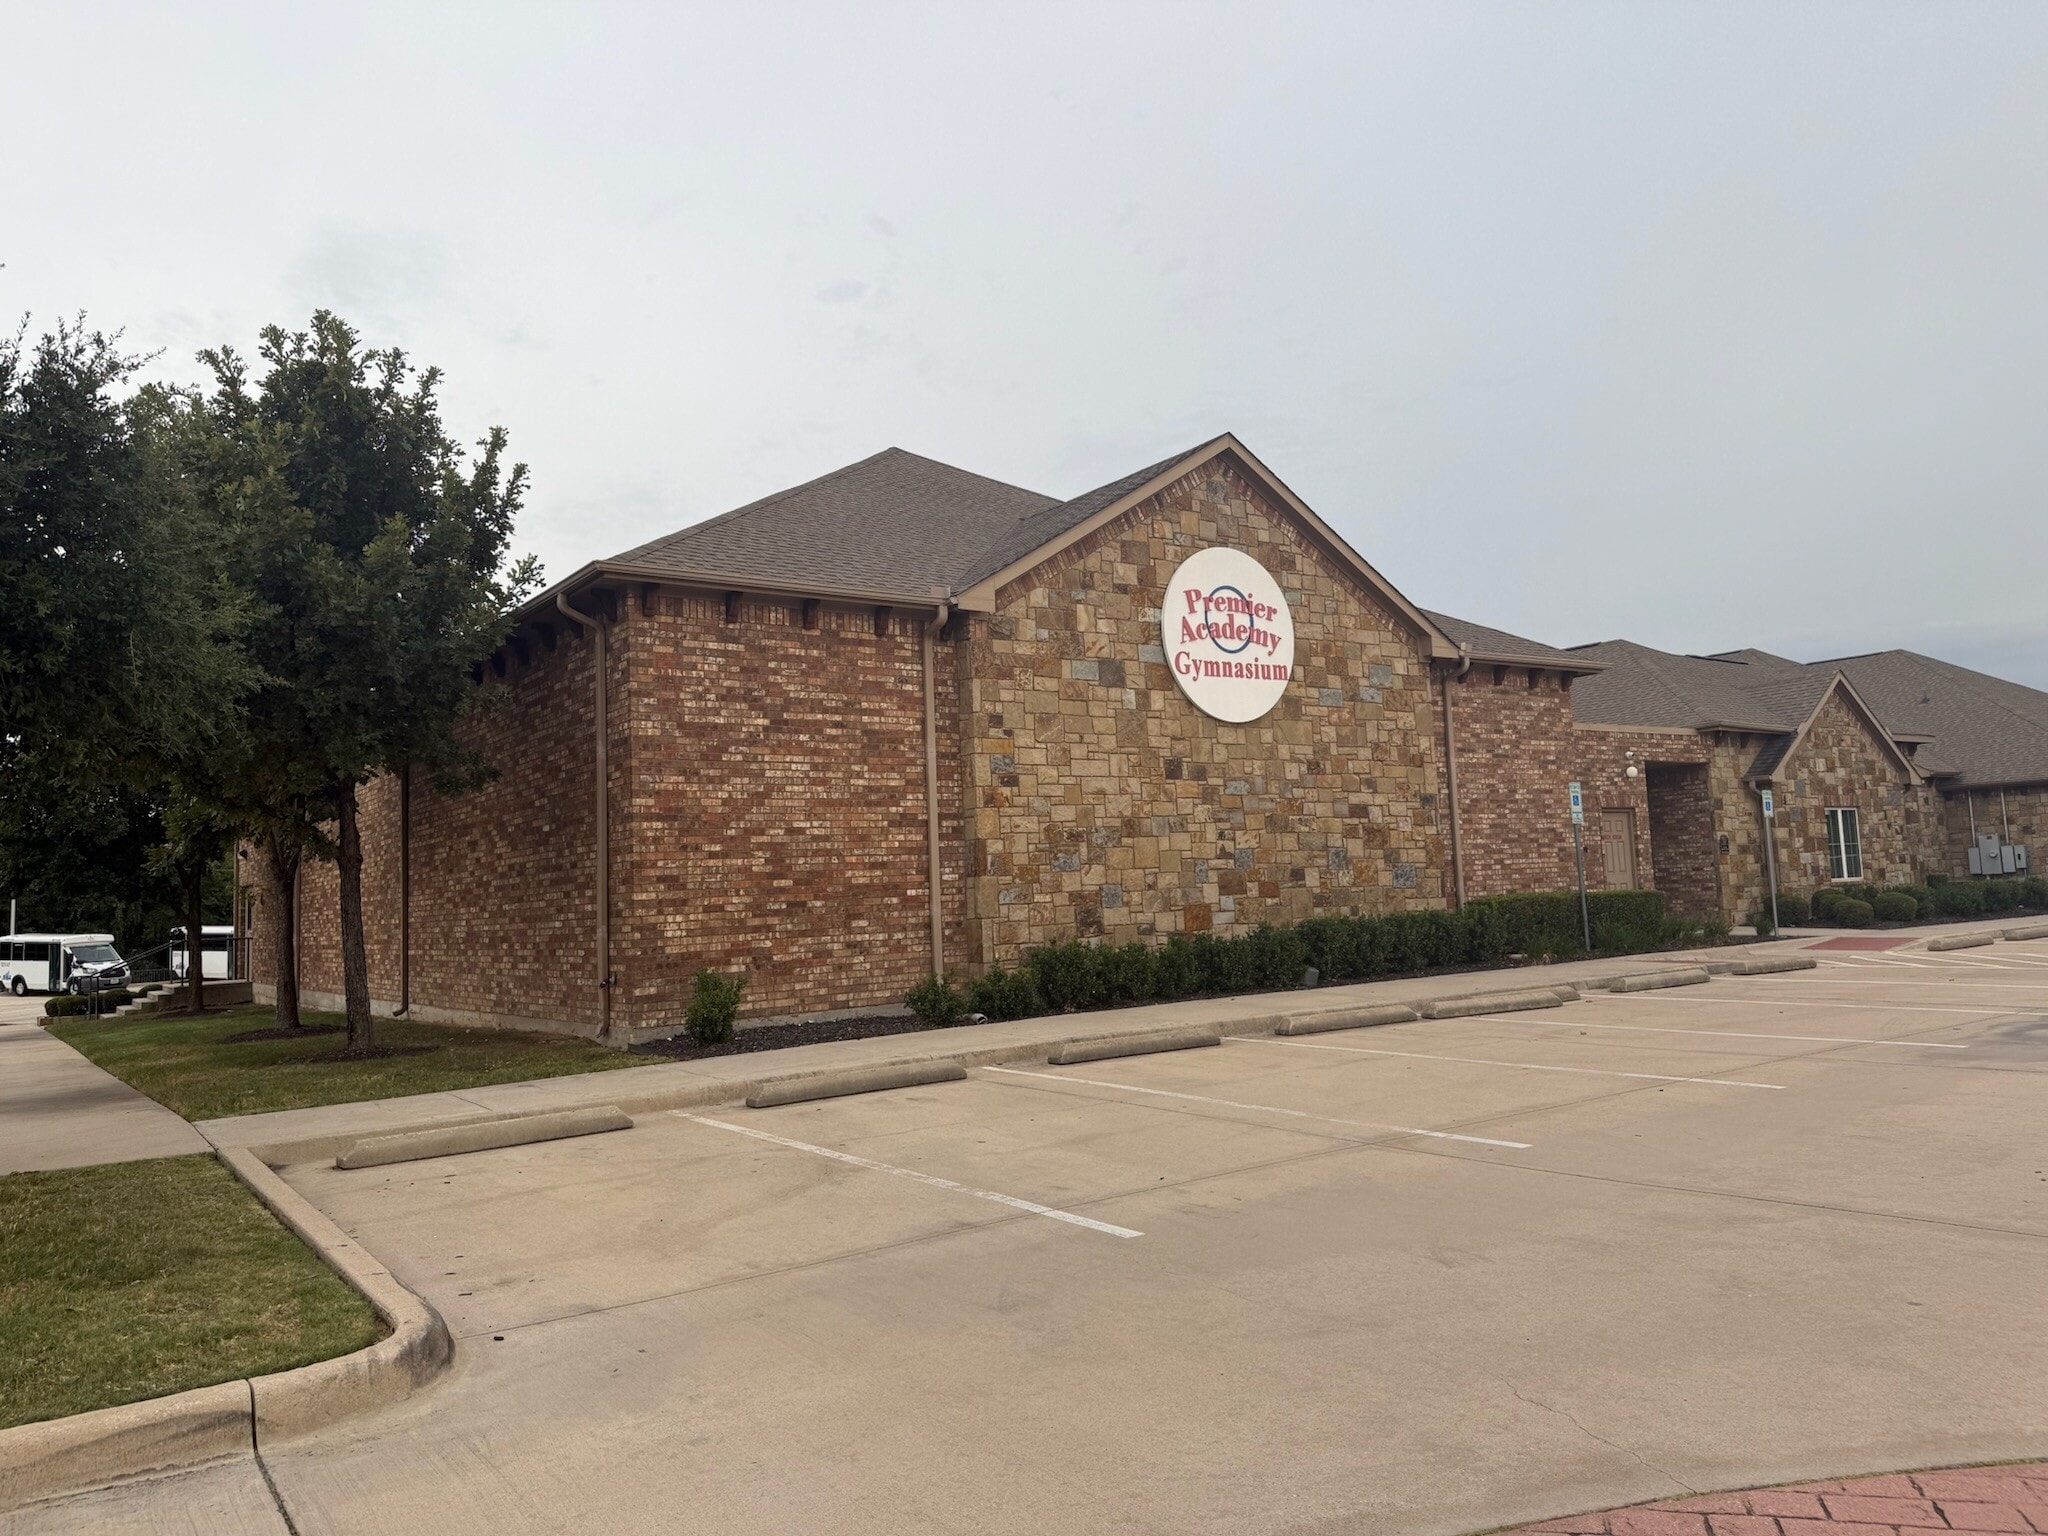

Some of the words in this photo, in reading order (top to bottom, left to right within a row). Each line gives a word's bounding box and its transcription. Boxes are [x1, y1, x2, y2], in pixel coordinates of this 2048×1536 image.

[1185, 589, 1277, 621] Premier
[1181, 614, 1281, 656] Academy
[1175, 652, 1289, 681] Gymnasium
